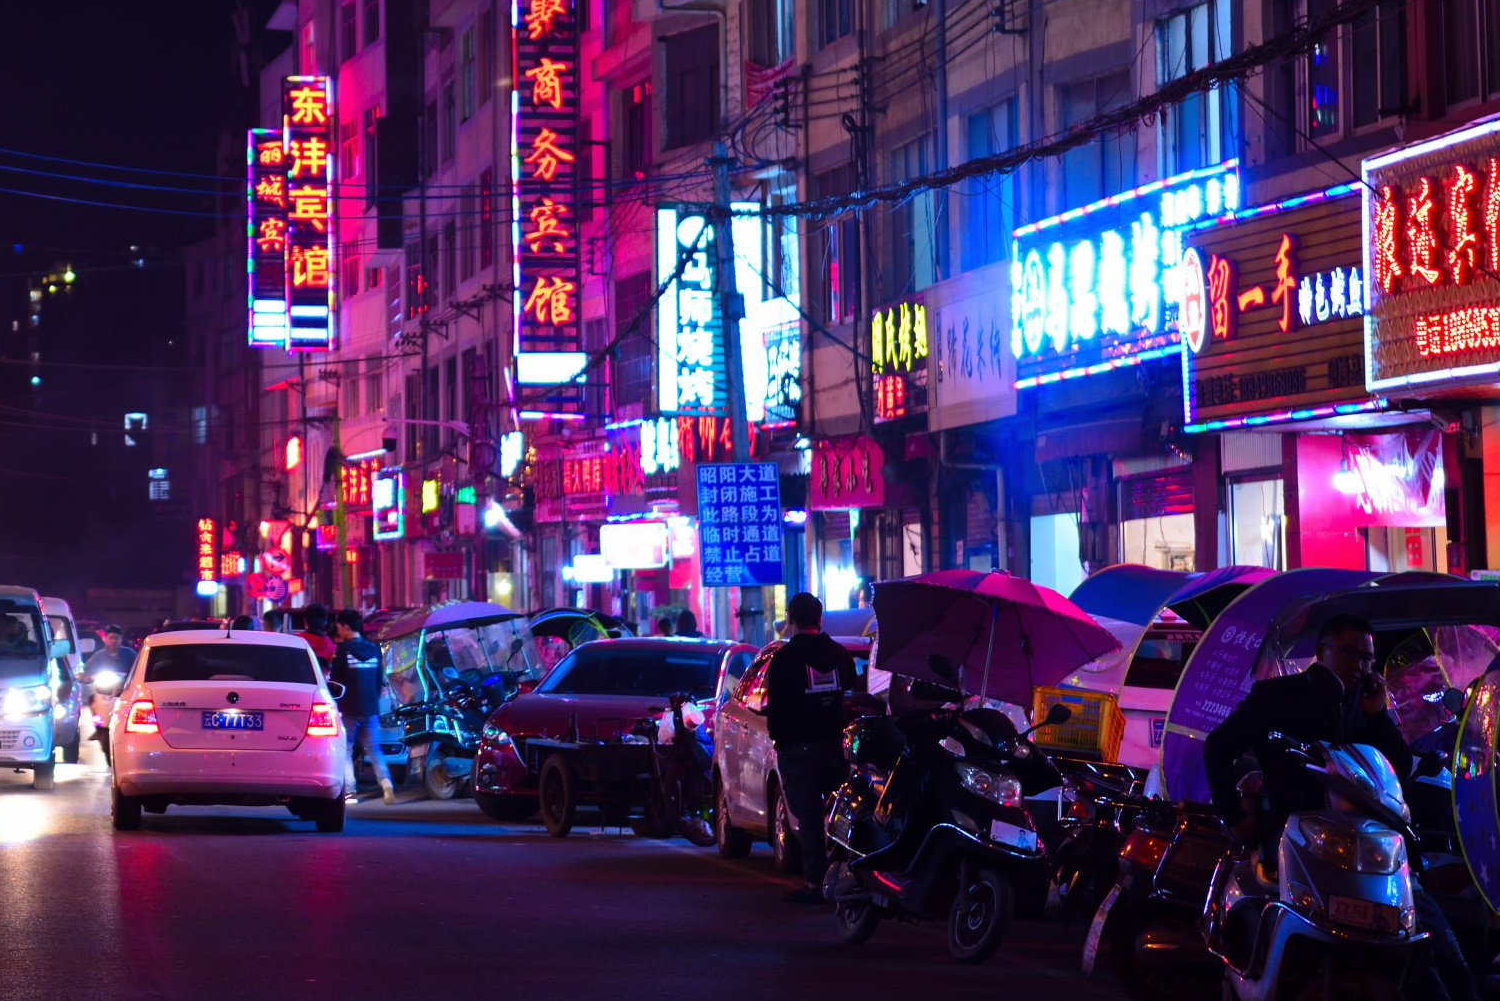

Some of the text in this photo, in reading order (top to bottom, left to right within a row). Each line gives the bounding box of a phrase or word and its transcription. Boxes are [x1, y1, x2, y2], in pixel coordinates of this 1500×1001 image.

[288, 87, 329, 289] 东沣宾馆
[1207, 232, 1297, 340] 留一手
[1298, 267, 1363, 326] 特色烤鱼
[699, 464, 777, 484] 昭阳大道
[700, 485, 778, 505] 封闭施工
[702, 505, 778, 524] 此路段为
[703, 525, 780, 544] 临时通道
[704, 545, 781, 564] 禁止占道
[705, 566, 743, 583] 经营
[1202, 699, 1232, 718] 2223466
